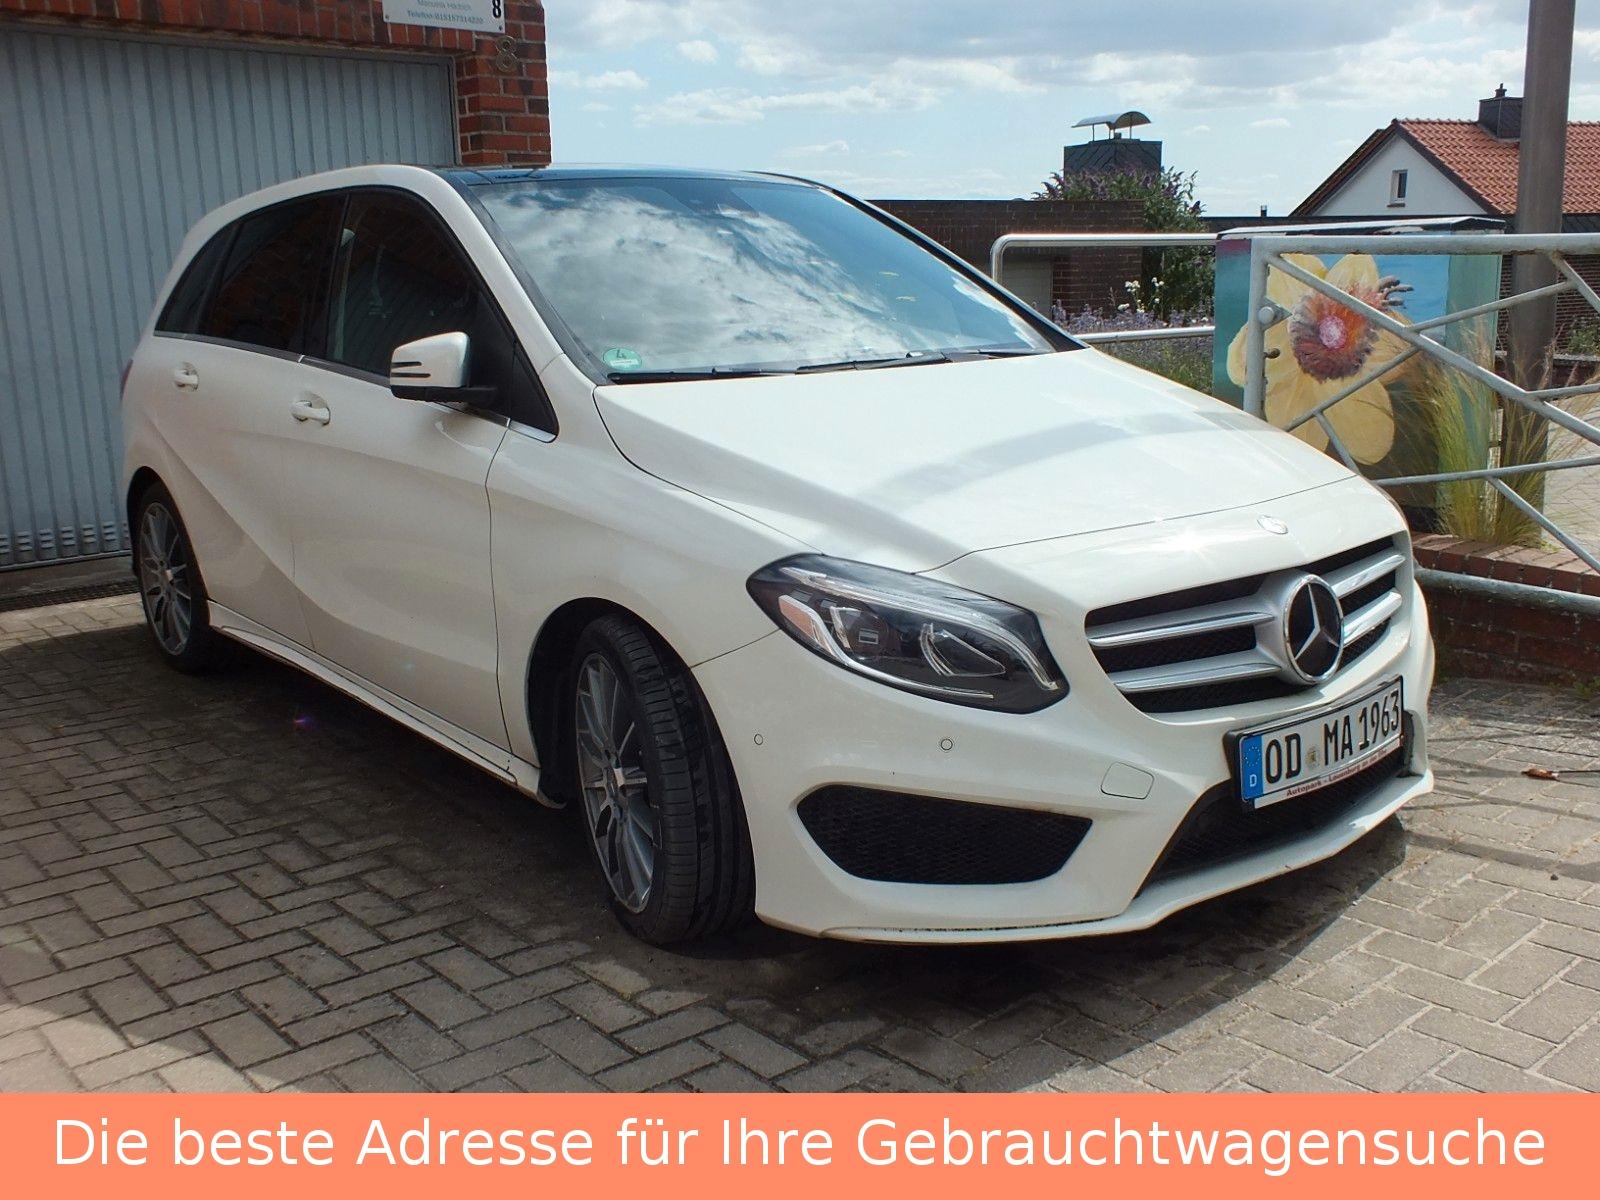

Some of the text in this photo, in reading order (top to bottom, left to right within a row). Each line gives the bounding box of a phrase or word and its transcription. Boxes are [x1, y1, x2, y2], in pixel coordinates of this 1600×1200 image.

[492, 0, 502, 18] 8
[496, 35, 517, 72] 8
[1265, 690, 1399, 784] OD MA 1963
[1249, 774, 1257, 788] D
[1286, 780, 1322, 796] Autopark
